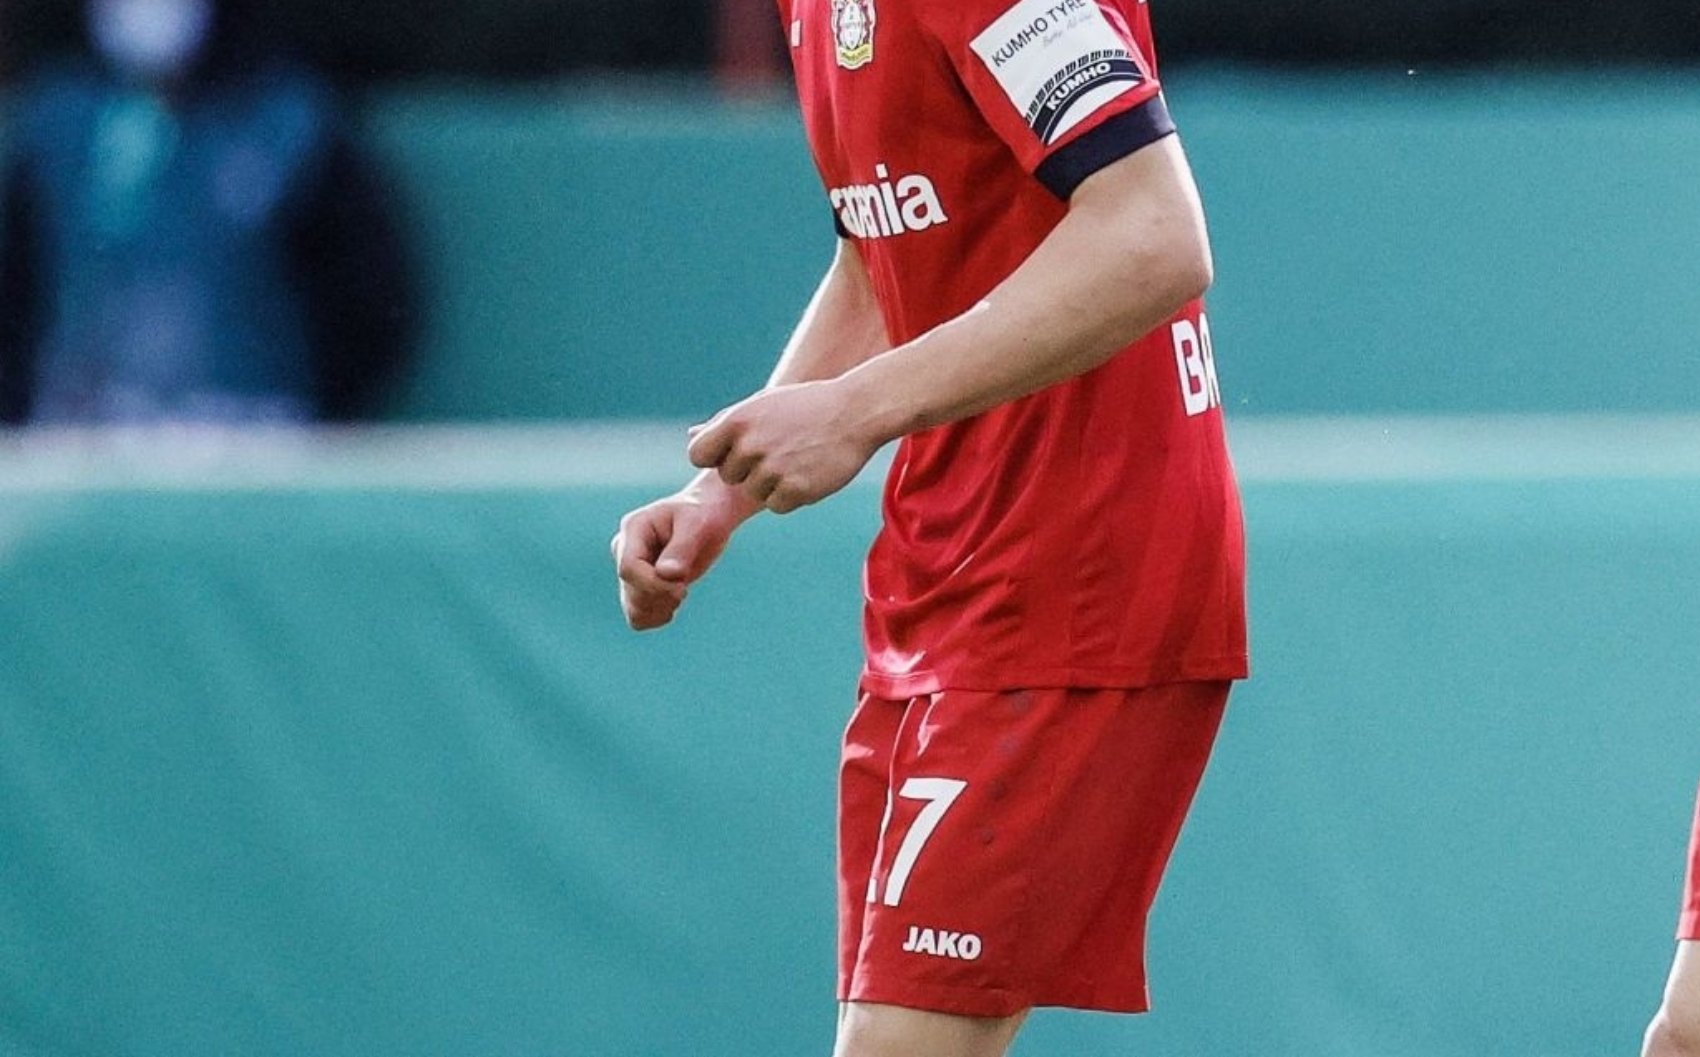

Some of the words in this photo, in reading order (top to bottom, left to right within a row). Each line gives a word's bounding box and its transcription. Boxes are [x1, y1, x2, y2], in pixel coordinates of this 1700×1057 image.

[991, 16, 1049, 68] KUMHO
[1045, 61, 1112, 111] KUMHO
[902, 926, 982, 961] JAKO
